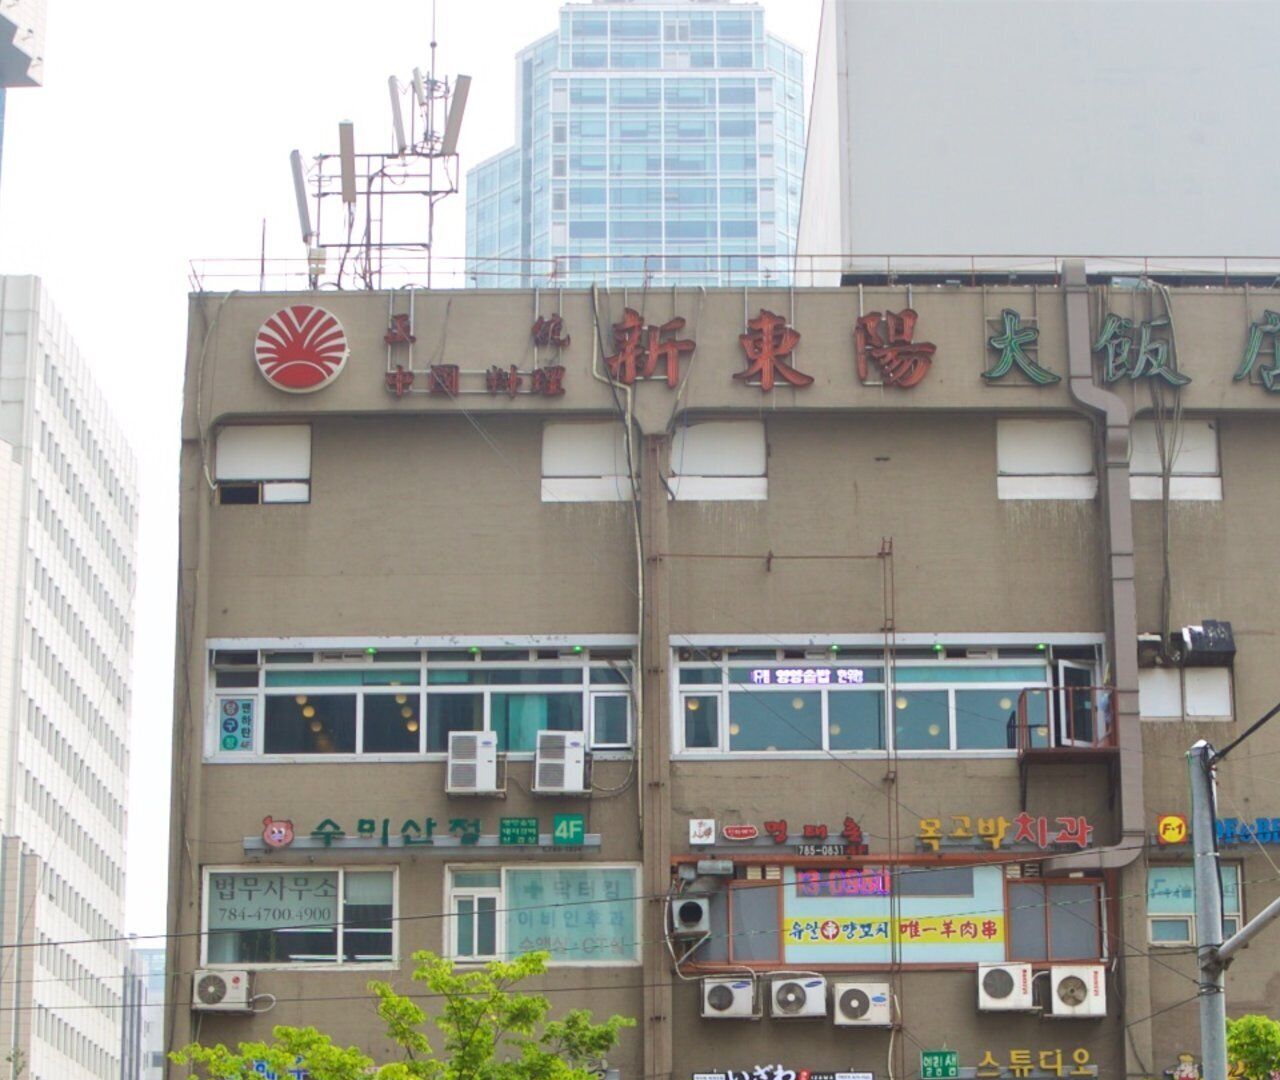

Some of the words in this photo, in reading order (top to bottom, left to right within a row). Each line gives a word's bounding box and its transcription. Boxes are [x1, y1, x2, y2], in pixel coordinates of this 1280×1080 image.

[554, 820, 584, 839] 4F
[214, 876, 338, 901] 법무사무소
[899, 919, 998, 940] 唯一羊肉串
[977, 1048, 1095, 1077] 스튜디오
